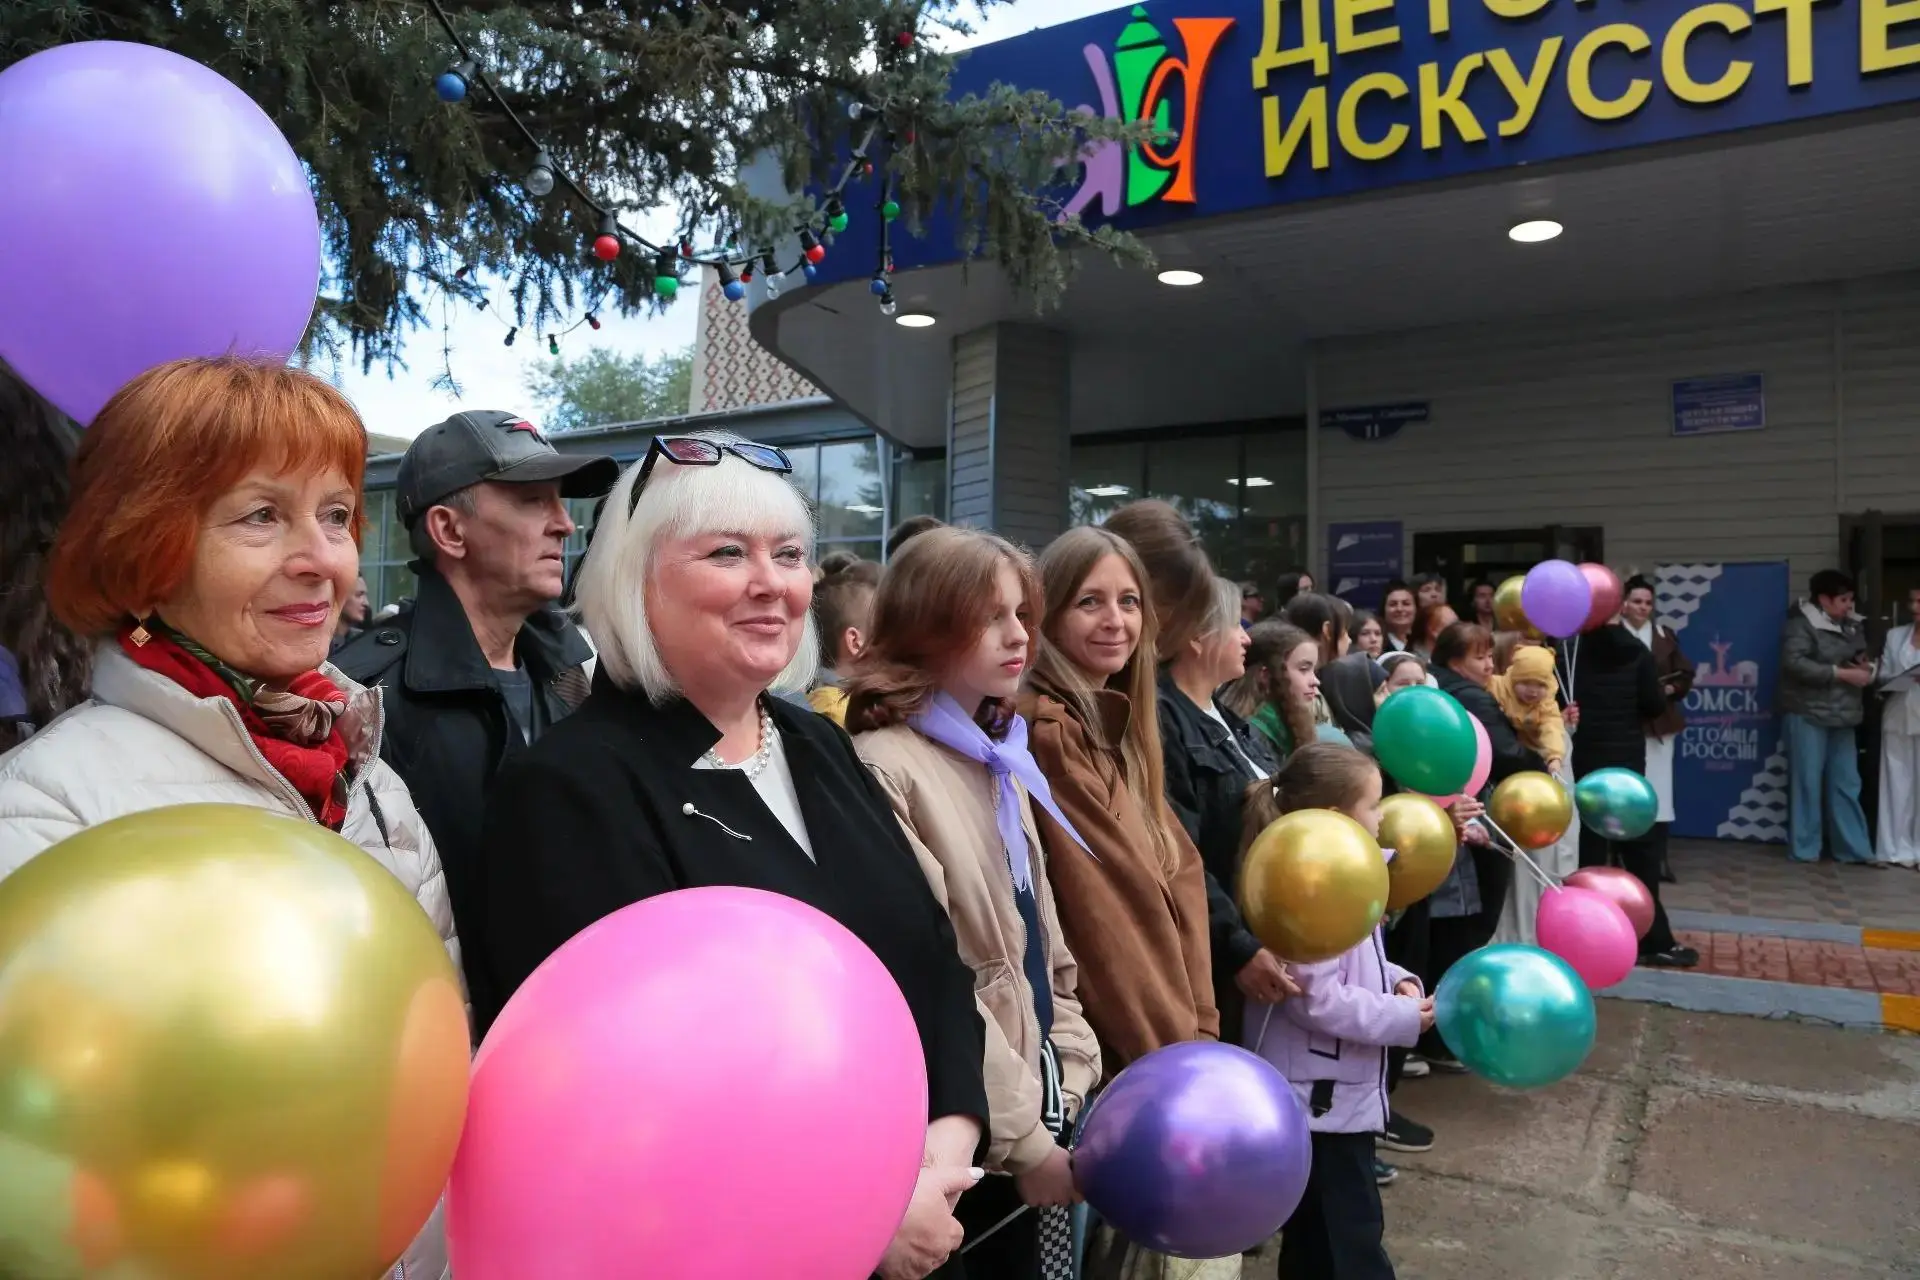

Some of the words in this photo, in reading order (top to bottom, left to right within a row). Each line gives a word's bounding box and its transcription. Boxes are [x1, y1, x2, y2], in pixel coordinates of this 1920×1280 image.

[1365, 423, 1380, 438] 11
[1683, 688, 1758, 712] ОМСК
[1682, 742, 1758, 760] РОССИИ
